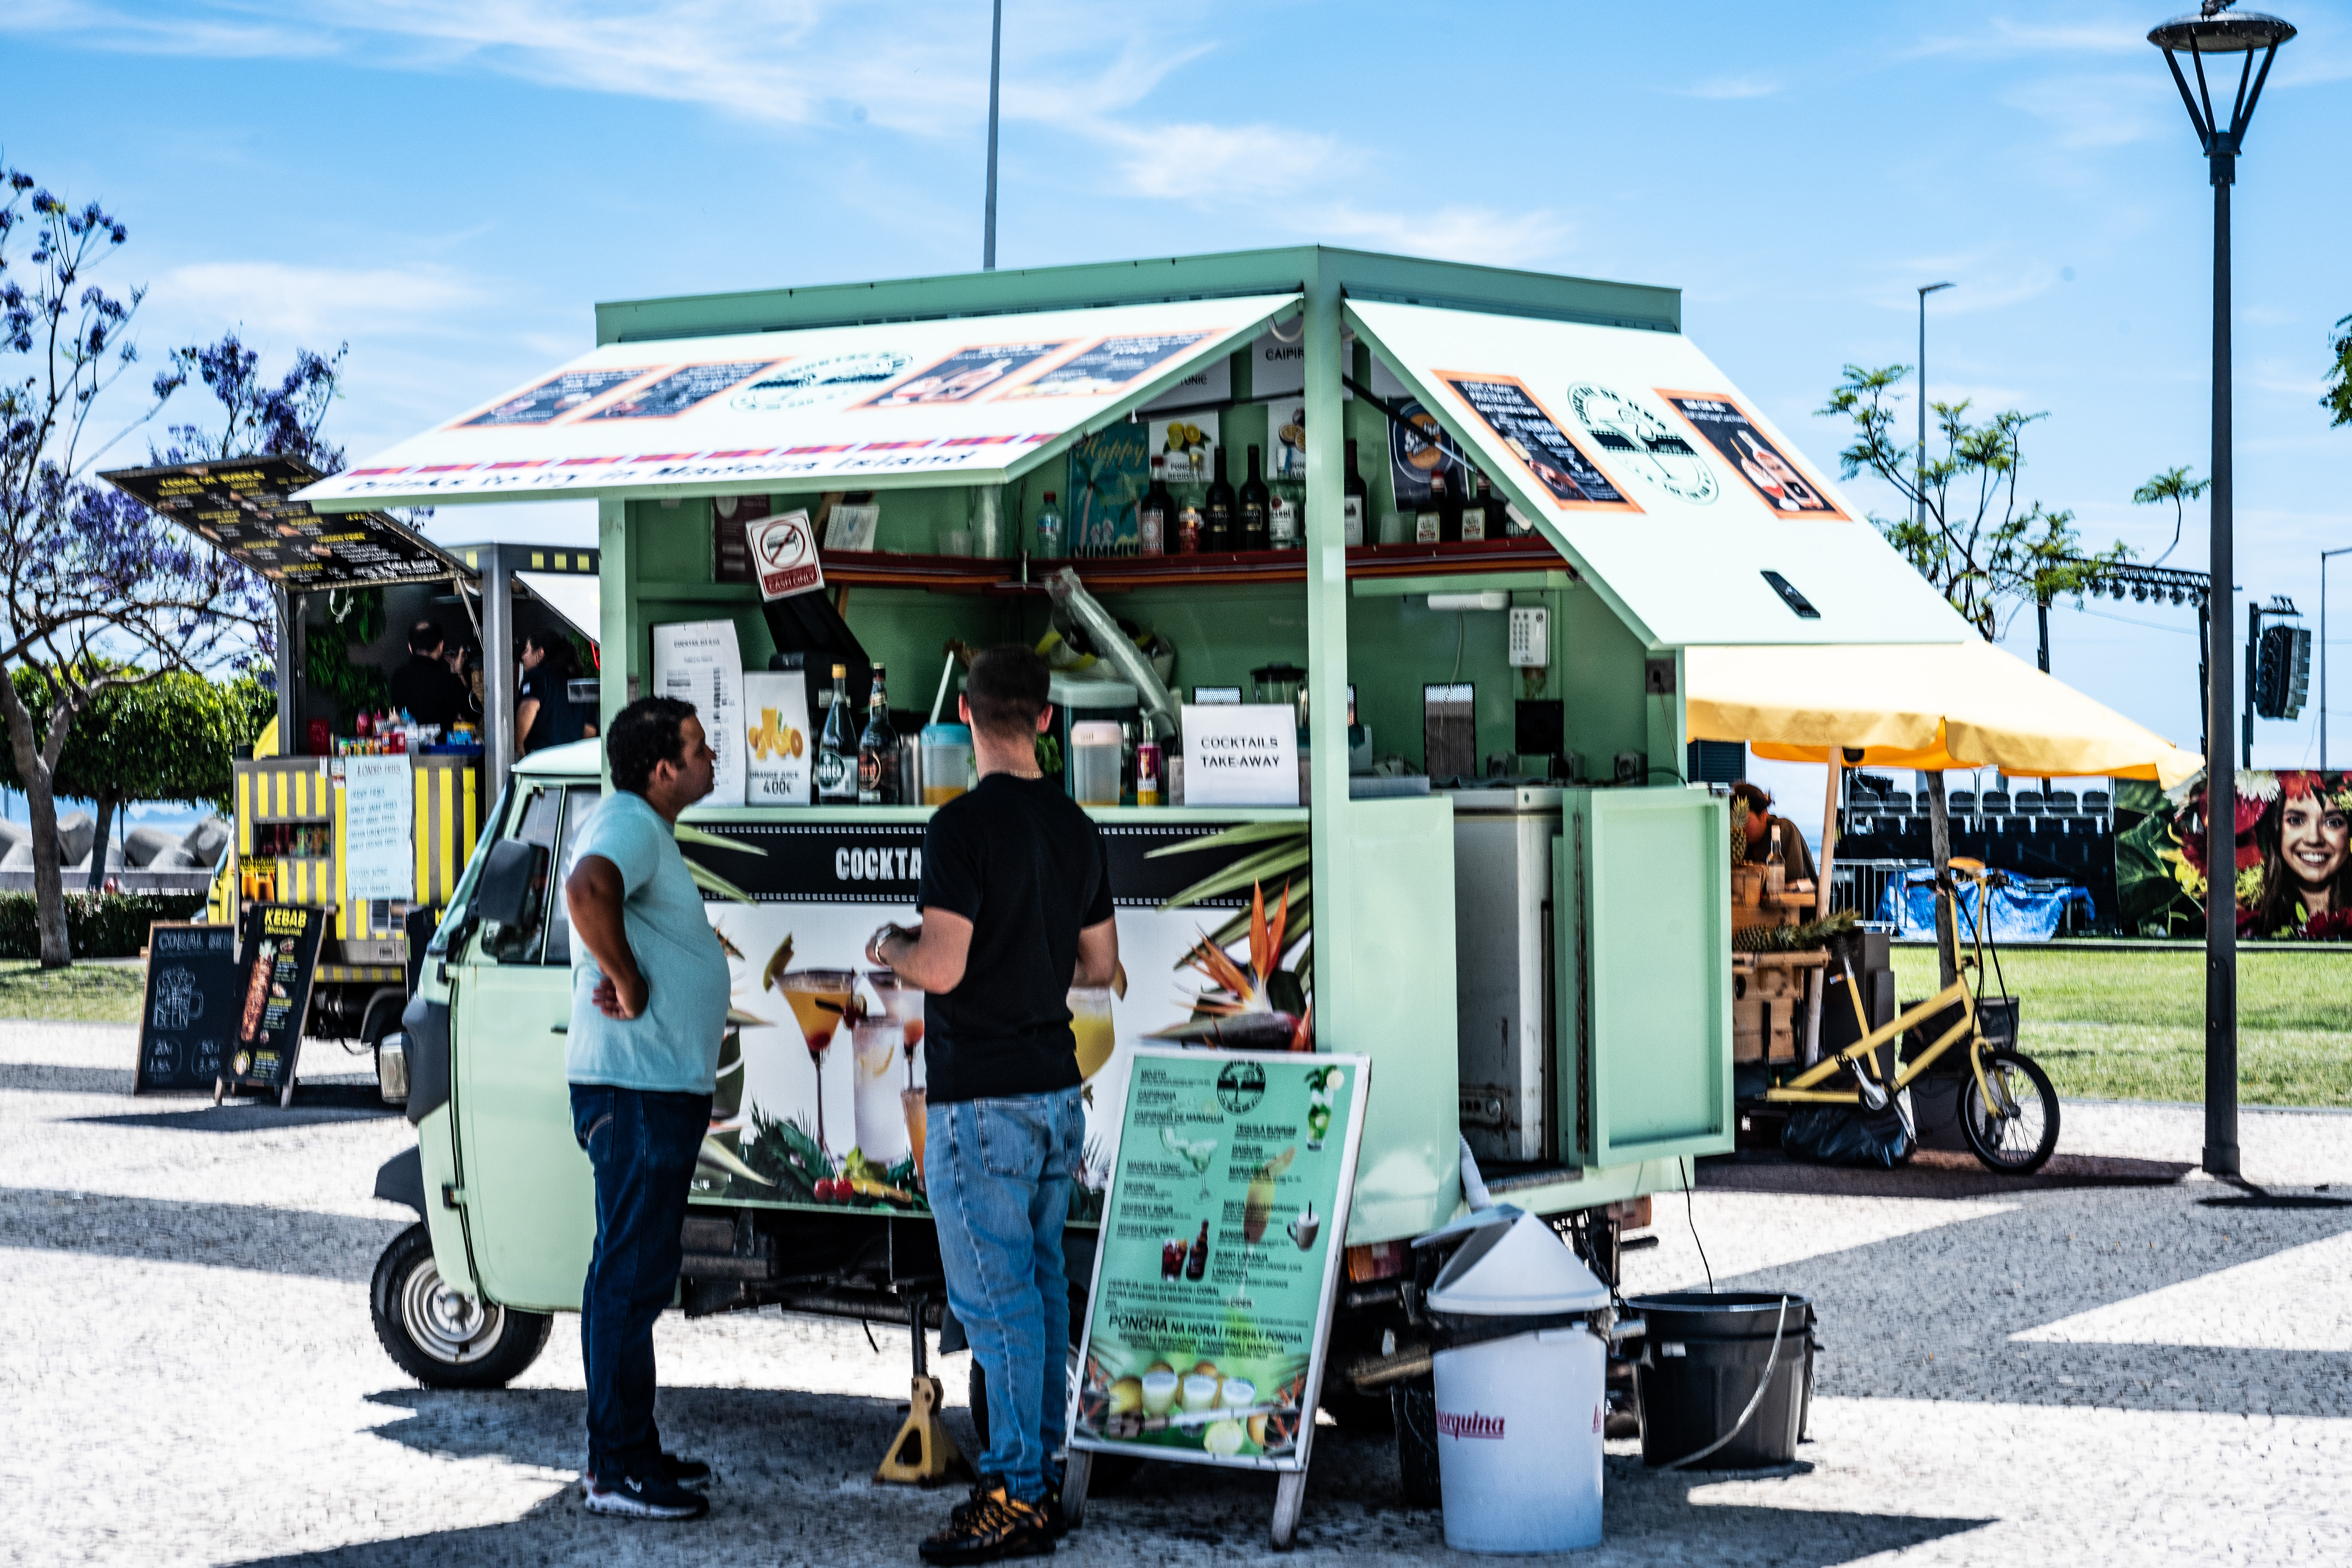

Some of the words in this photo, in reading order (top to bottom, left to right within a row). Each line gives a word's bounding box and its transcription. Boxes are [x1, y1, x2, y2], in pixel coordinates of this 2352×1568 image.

[768, 578, 792, 592] CASH
[792, 569, 816, 587] ONLY
[1201, 735, 1278, 749] COCKTAILS
[749, 769, 778, 780] ORANGE
[780, 769, 800, 780] JUICE
[264, 907, 307, 928] KEBAB
[158, 931, 203, 951] CORAL
[1137, 1089, 1177, 1101] CAIPIRINHA
[1134, 1109, 1173, 1123] CAIPIRINHA
[1236, 1122, 1266, 1136] TEQUILA
[1266, 1124, 1297, 1138] SUNRISE
[1123, 1180, 1156, 1194] NEGRONI
[1108, 1312, 1168, 1333] PONCHA
[1170, 1321, 1185, 1335] NA
[1187, 1322, 1217, 1337] HORA
[1224, 1325, 1262, 1341] FRESHLY
[1265, 1328, 1303, 1345] PONCHA
